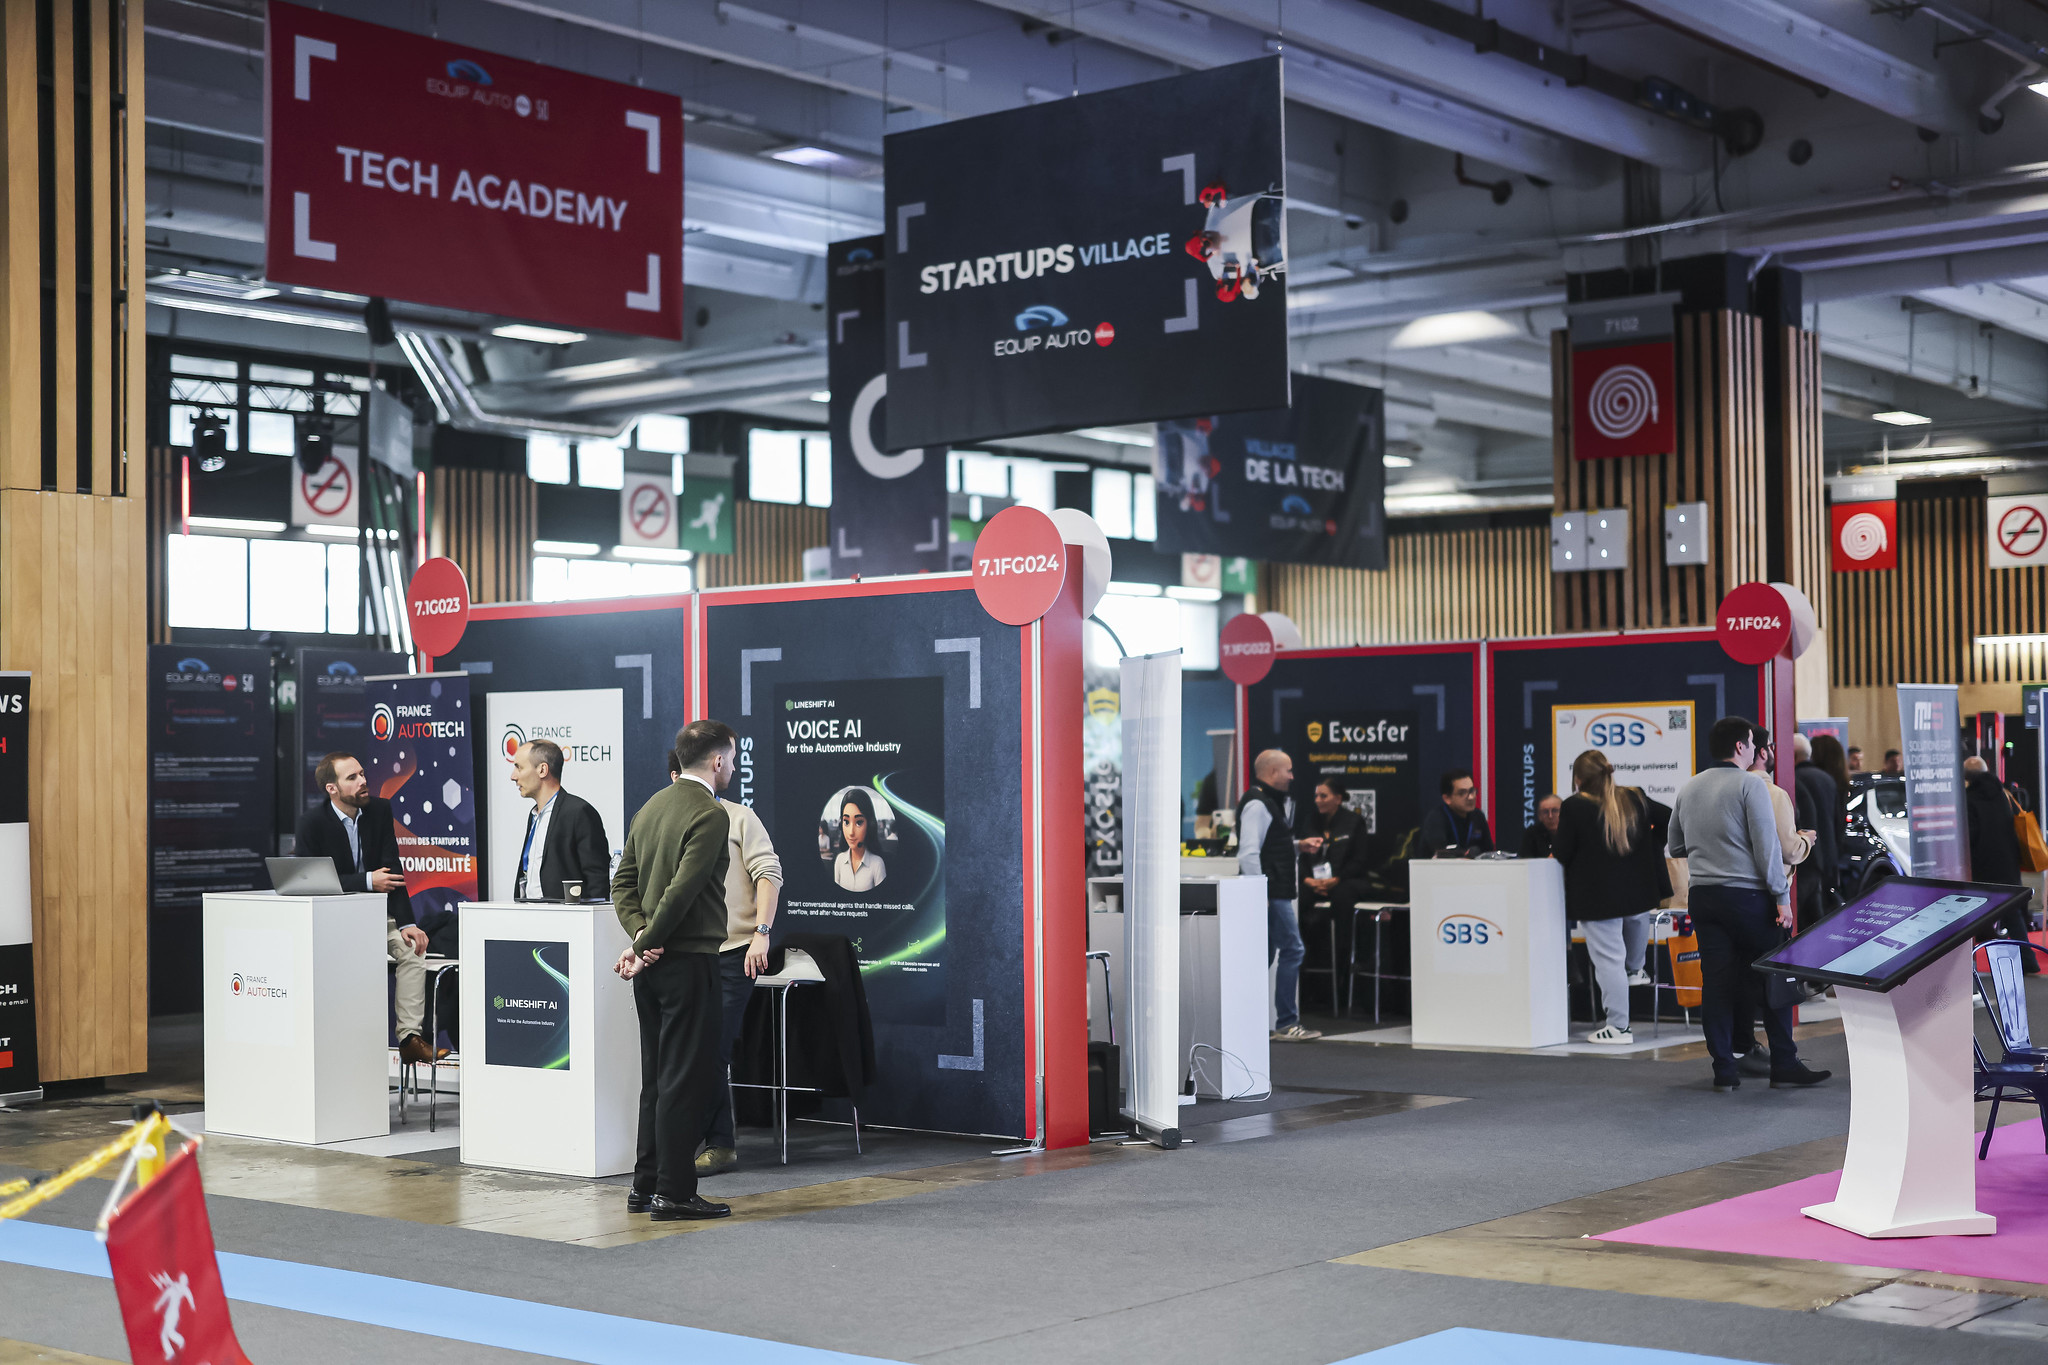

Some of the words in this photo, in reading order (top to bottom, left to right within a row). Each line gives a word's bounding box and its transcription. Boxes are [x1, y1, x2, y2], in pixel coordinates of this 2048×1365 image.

[336, 146, 439, 198] TECH
[451, 170, 628, 232] ACADEMY
[920, 243, 1075, 294] STARTUPS
[1078, 233, 1170, 267] VILLAGE
[994, 335, 1042, 356] EQUIP
[1045, 329, 1091, 350] AUTO
[1245, 458, 1271, 483] DE
[1274, 462, 1297, 486] LA
[1300, 465, 1345, 492] TECH
[978, 553, 1060, 577] 7.1FG024
[414, 596, 461, 617] 7.1G023
[1726, 615, 1781, 631] 7.1F024
[396, 704, 432, 717] FRANCE
[794, 700, 827, 709] LINESHIFT
[827, 700, 835, 708] AI
[398, 720, 465, 739] AUTOTECH
[531, 726, 572, 738] FRANCE
[786, 720, 840, 739] VOICE
[844, 719, 862, 738] AI
[1329, 719, 1409, 743] Exosfer
[1590, 722, 1645, 747] SBS
[786, 743, 798, 754] for
[799, 743, 814, 753] the
[815, 742, 864, 753] Automotive
[866, 741, 901, 754] Industry
[1348, 753, 1358, 761] de
[740, 736, 754, 811] RTUPS
[1642, 762, 1678, 770] universel
[1523, 743, 1535, 829] STARTUPS
[1647, 785, 1675, 793] Ducato
[418, 837, 430, 846] DES
[430, 837, 460, 846] STARTUPS
[460, 837, 470, 845] DE
[1443, 923, 1488, 944] SBS
[246, 975, 267, 984] FRANCE
[247, 987, 287, 998] AUTOTECH
[505, 999, 547, 1009] LINESHIFT
[548, 1001, 558, 1009] AI
